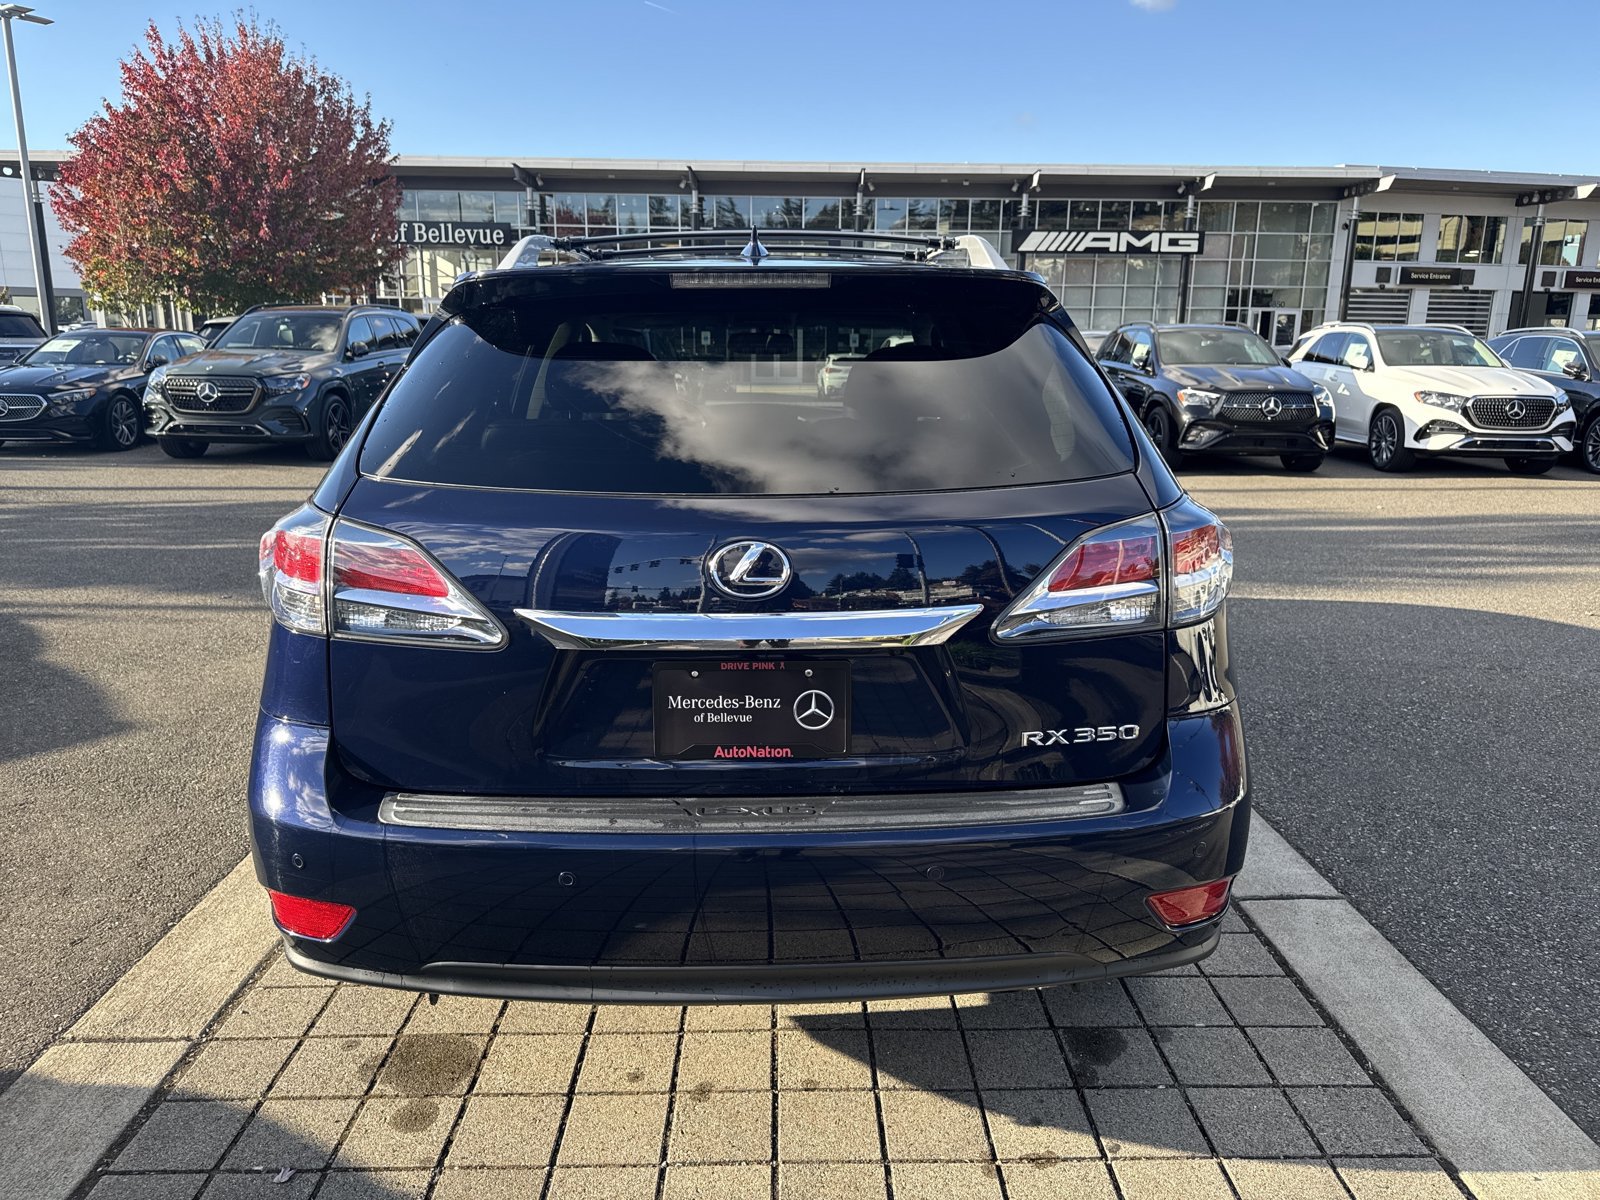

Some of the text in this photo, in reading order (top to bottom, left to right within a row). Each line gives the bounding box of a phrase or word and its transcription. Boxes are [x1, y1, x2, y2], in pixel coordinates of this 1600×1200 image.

[412, 222, 504, 245] Bellevue
[1075, 231, 1200, 253] AMG
[1410, 272, 1451, 280] Service Entrance
[1575, 276, 1592, 284] Service
[720, 662, 776, 671] DRIVE PINK
[667, 694, 782, 710] Mercedes-Benz
[693, 712, 753, 723] of Bellevue
[1020, 724, 1140, 747] RX 350
[713, 745, 792, 759] AutoNation
